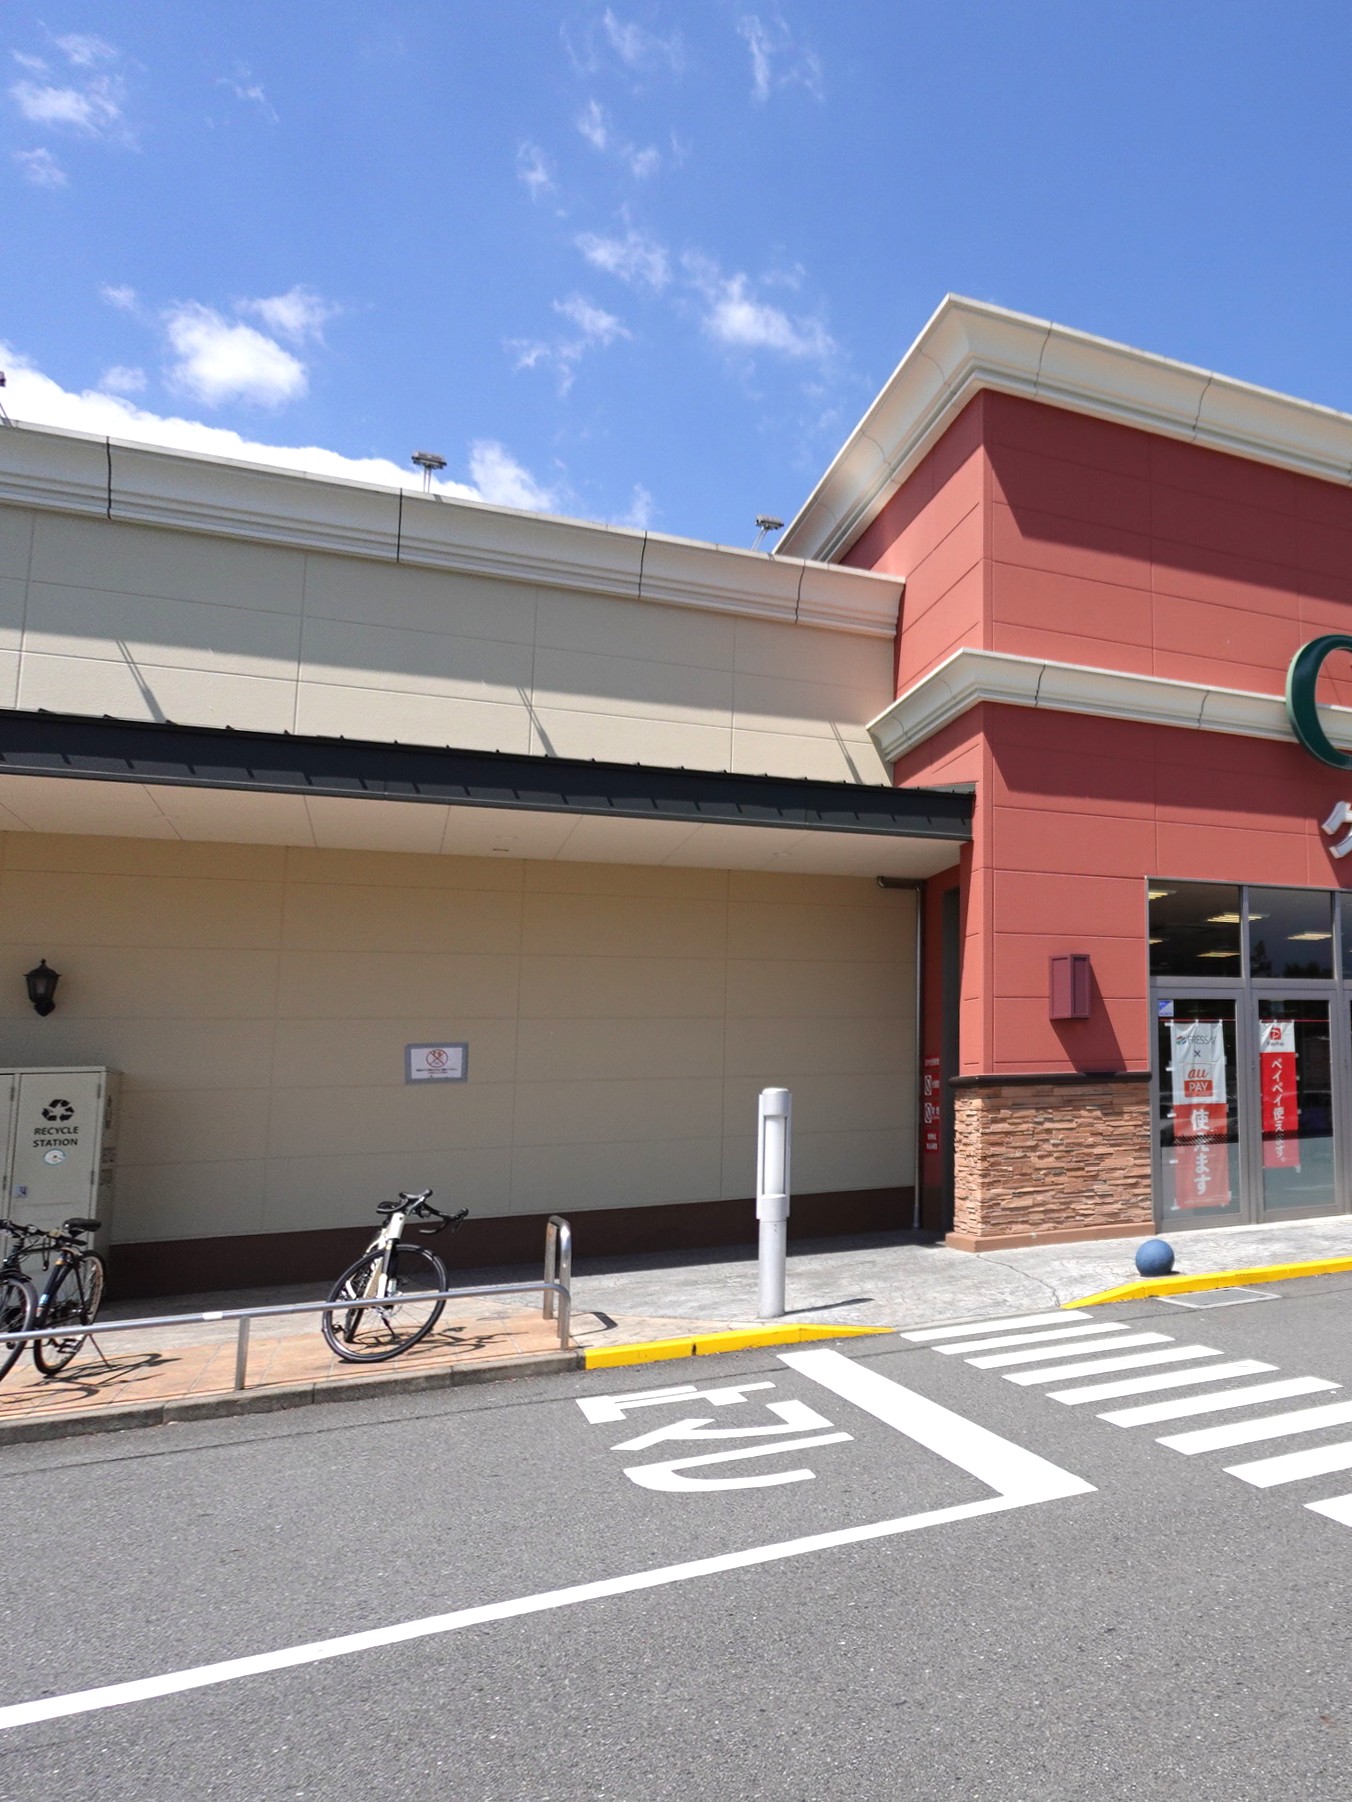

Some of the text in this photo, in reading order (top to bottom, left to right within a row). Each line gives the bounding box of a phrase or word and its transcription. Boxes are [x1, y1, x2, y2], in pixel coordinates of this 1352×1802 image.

[1188, 1068, 1209, 1079] au
[1189, 1081, 1209, 1093] PAY
[34, 1126, 79, 1136] RECYCLE
[33, 1138, 78, 1148] STATION
[1191, 1109, 1212, 1196] 使えます
